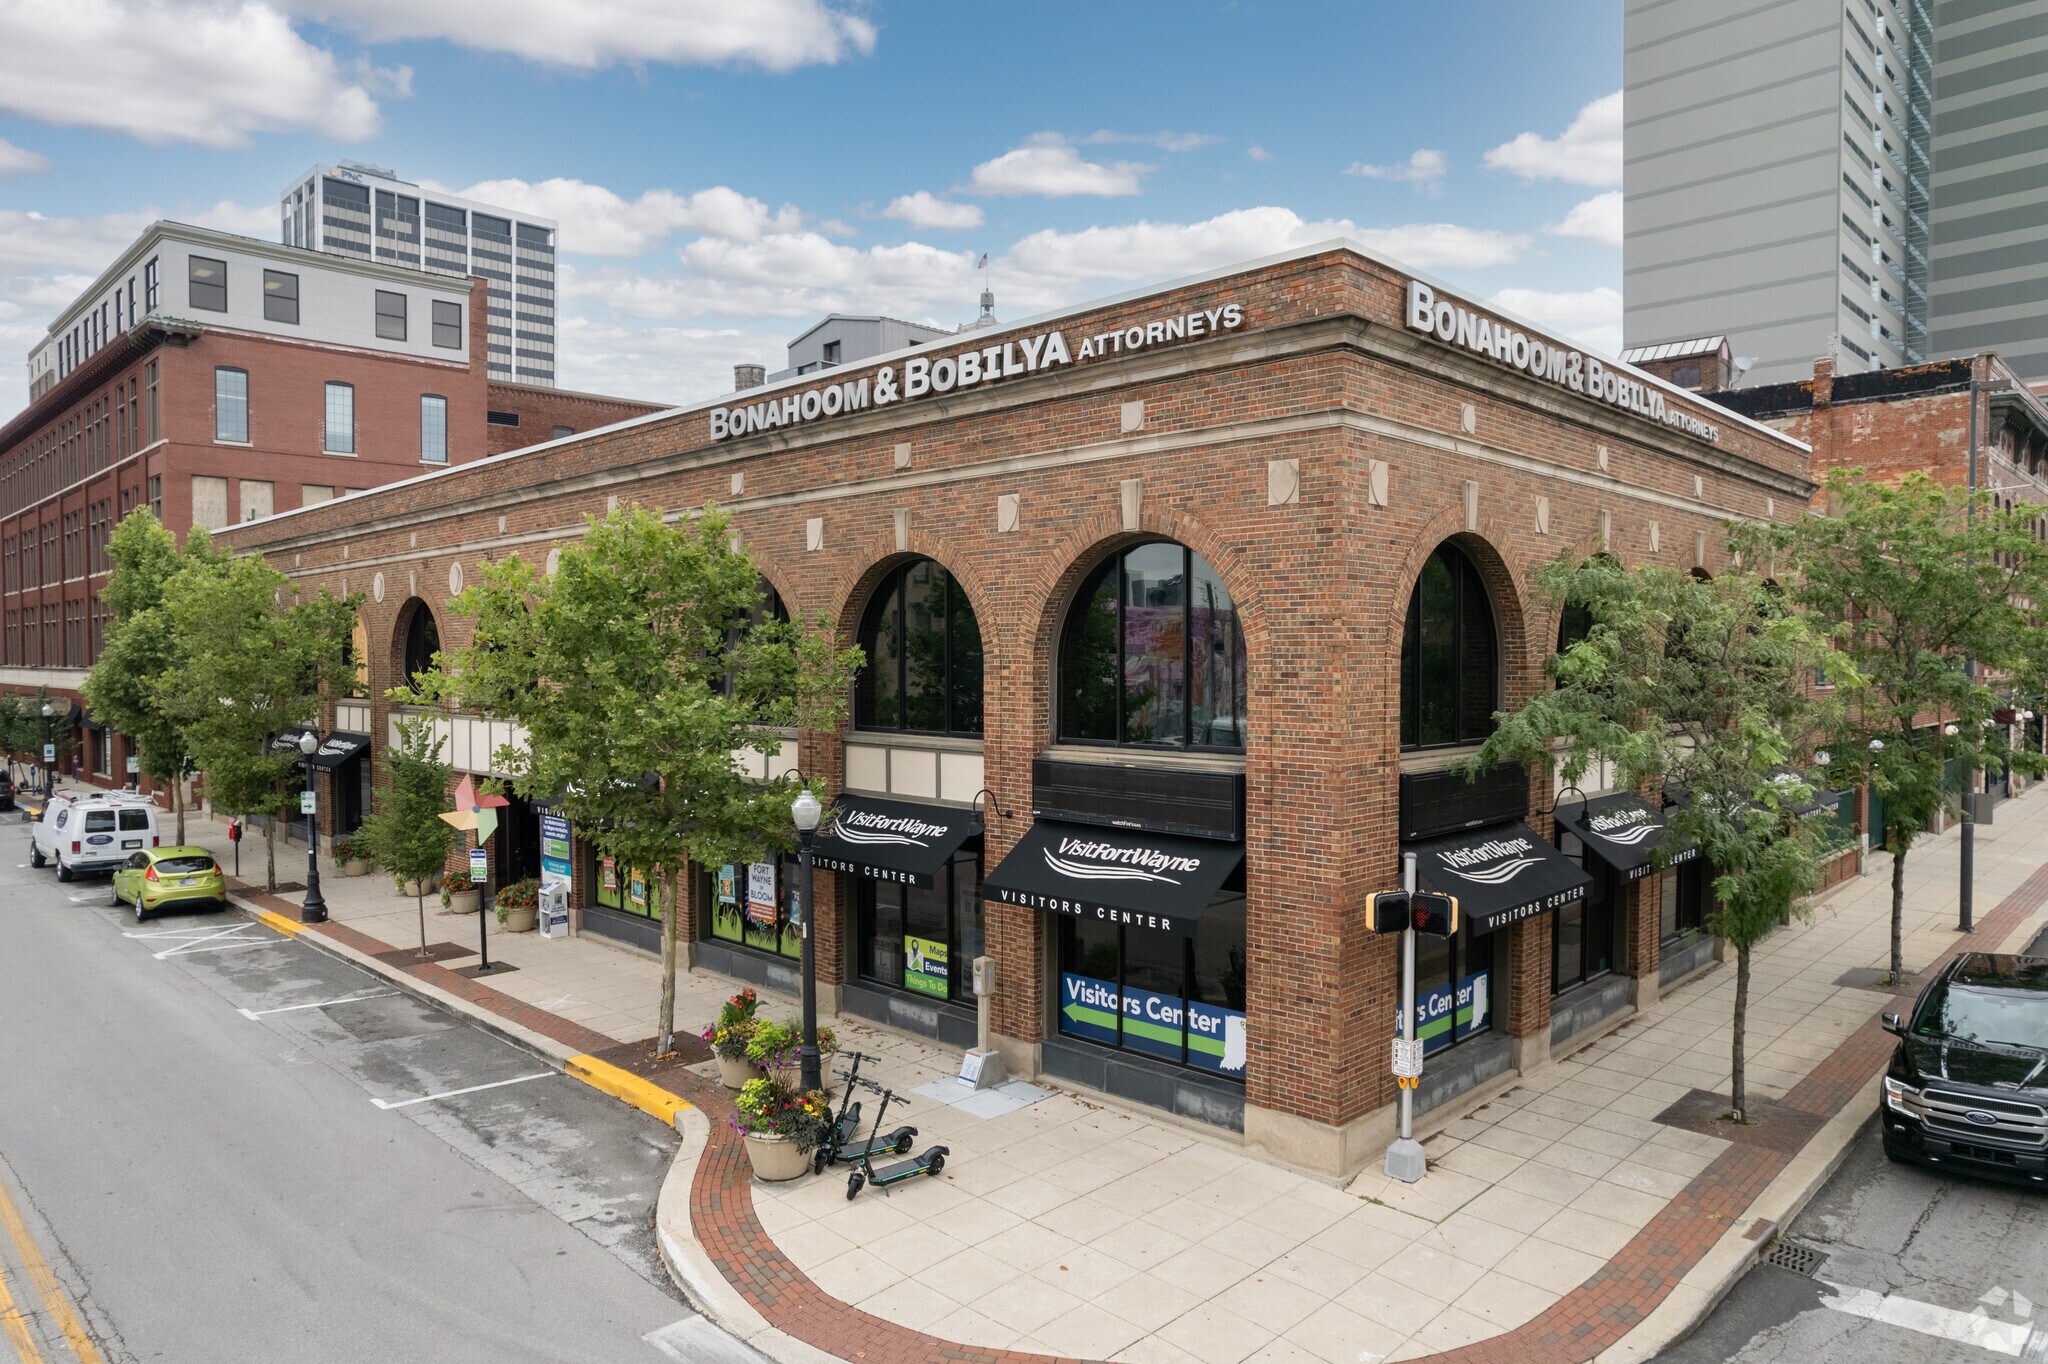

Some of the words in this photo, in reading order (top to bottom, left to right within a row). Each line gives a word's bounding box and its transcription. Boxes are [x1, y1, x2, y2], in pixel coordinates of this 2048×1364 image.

[341, 170, 362, 182] PNC
[1406, 280, 1567, 384] BONAHOOM
[1566, 351, 1585, 393] &
[1585, 357, 1668, 422] BOBILYA
[1669, 410, 1719, 442] ATTORNEYS
[710, 376, 869, 441] BONAHOOM
[873, 366, 898, 405] &
[904, 331, 1072, 399] BOBILYA
[1078, 303, 1244, 360] ATTORNEYS
[753, 864, 769, 876] FORT
[797, 853, 855, 873] VSITORS
[864, 866, 916, 885] CENTER
[751, 874, 772, 886] WAYNE
[750, 889, 773, 903] BLOOM
[1001, 889, 1083, 914] VISITORS
[1097, 907, 1172, 931] CENTER
[1488, 901, 1541, 928] VISITORS
[1547, 886, 1585, 909] CENTER
[929, 945, 948, 959] Maps
[925, 961, 948, 976] Events
[906, 974, 928, 988] Things
[927, 980, 936, 990] To
[938, 983, 948, 993] Do
[1066, 976, 1141, 1016] Visitors
[1146, 996, 1221, 1035] Center
